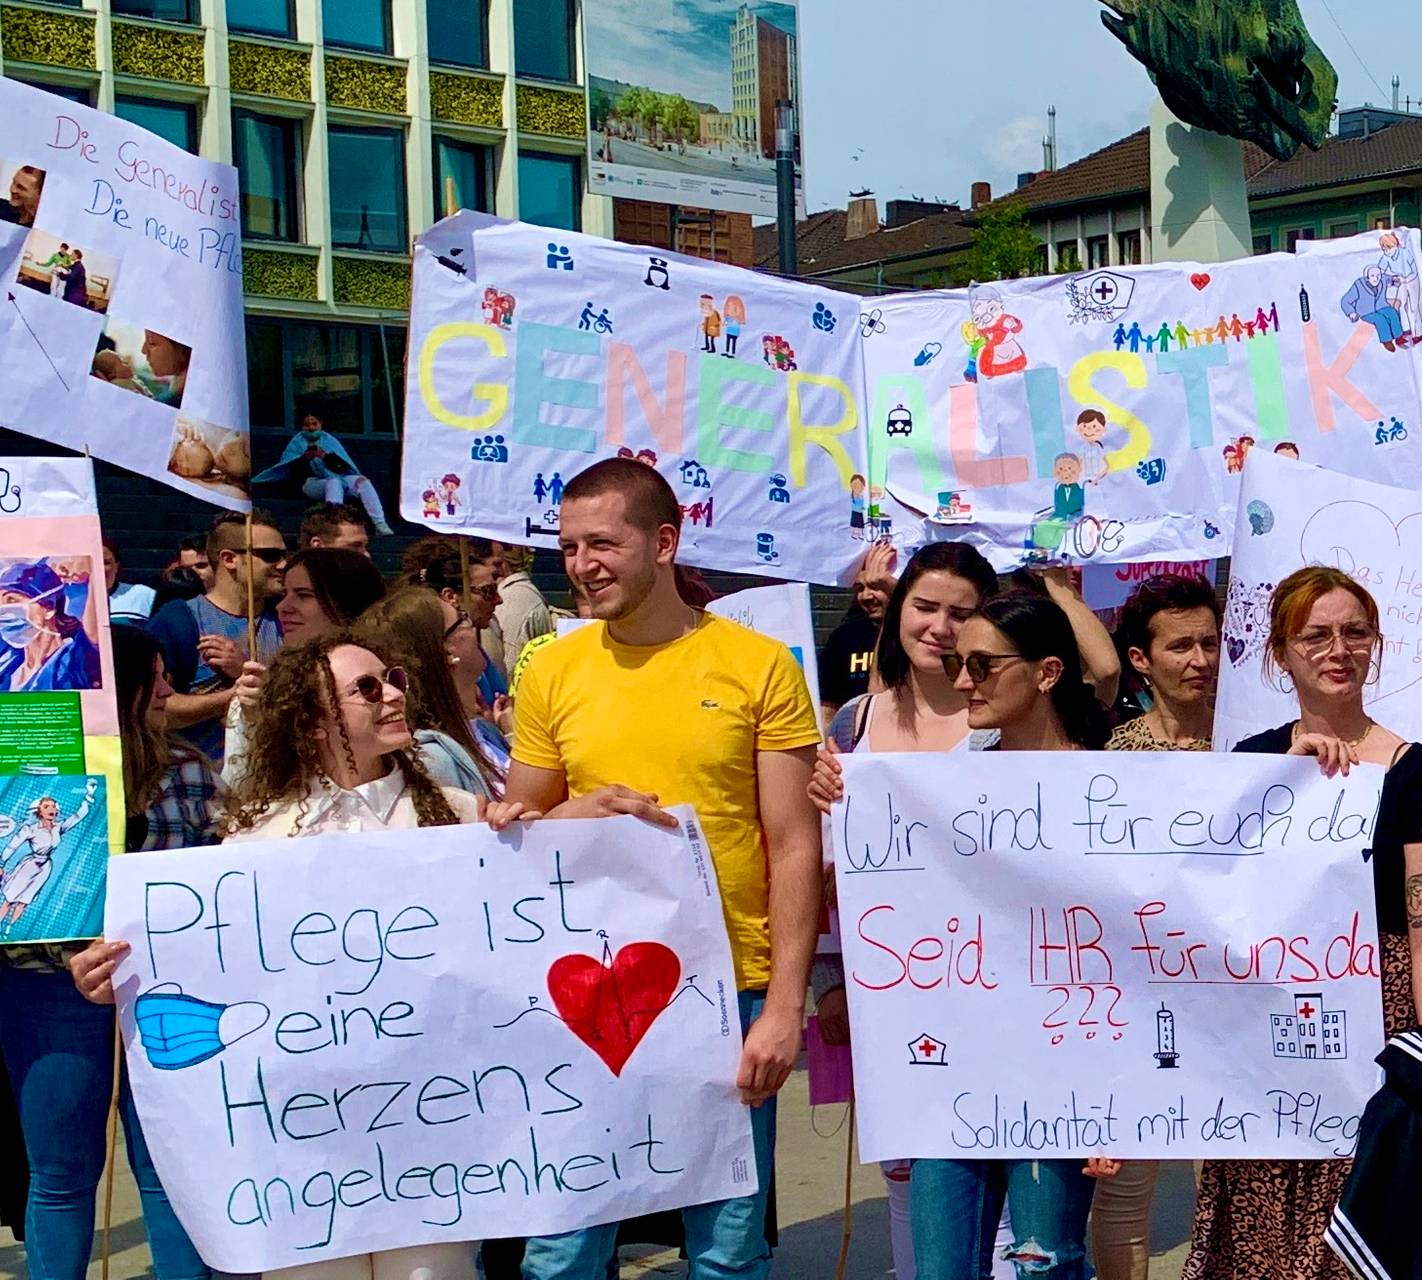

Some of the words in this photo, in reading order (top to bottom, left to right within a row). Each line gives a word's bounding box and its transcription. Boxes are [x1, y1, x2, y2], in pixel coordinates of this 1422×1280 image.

[47, 116, 99, 163] Die
[85, 179, 131, 228] Die
[146, 217, 190, 257] neue
[418, 320, 1385, 492] GENERALISTIK
[845, 792, 928, 869] Wir
[953, 781, 1053, 856] sind
[1072, 774, 1153, 849] für
[1169, 784, 1295, 852] euch
[145, 870, 438, 995] Pflege
[480, 850, 592, 952] ist
[852, 905, 998, 990] Seid
[1029, 905, 1114, 985] IHR
[1131, 902, 1206, 980] für
[1223, 935, 1321, 983] uns
[275, 996, 422, 1053] eine
[220, 1057, 584, 1147] Herzens
[951, 1091, 1118, 1149] Solidarität
[1137, 1097, 1190, 1143] mit
[1201, 1098, 1260, 1143] der
[1266, 1090, 1361, 1156] Pfleg
[227, 1114, 684, 1250] angelegenheit
